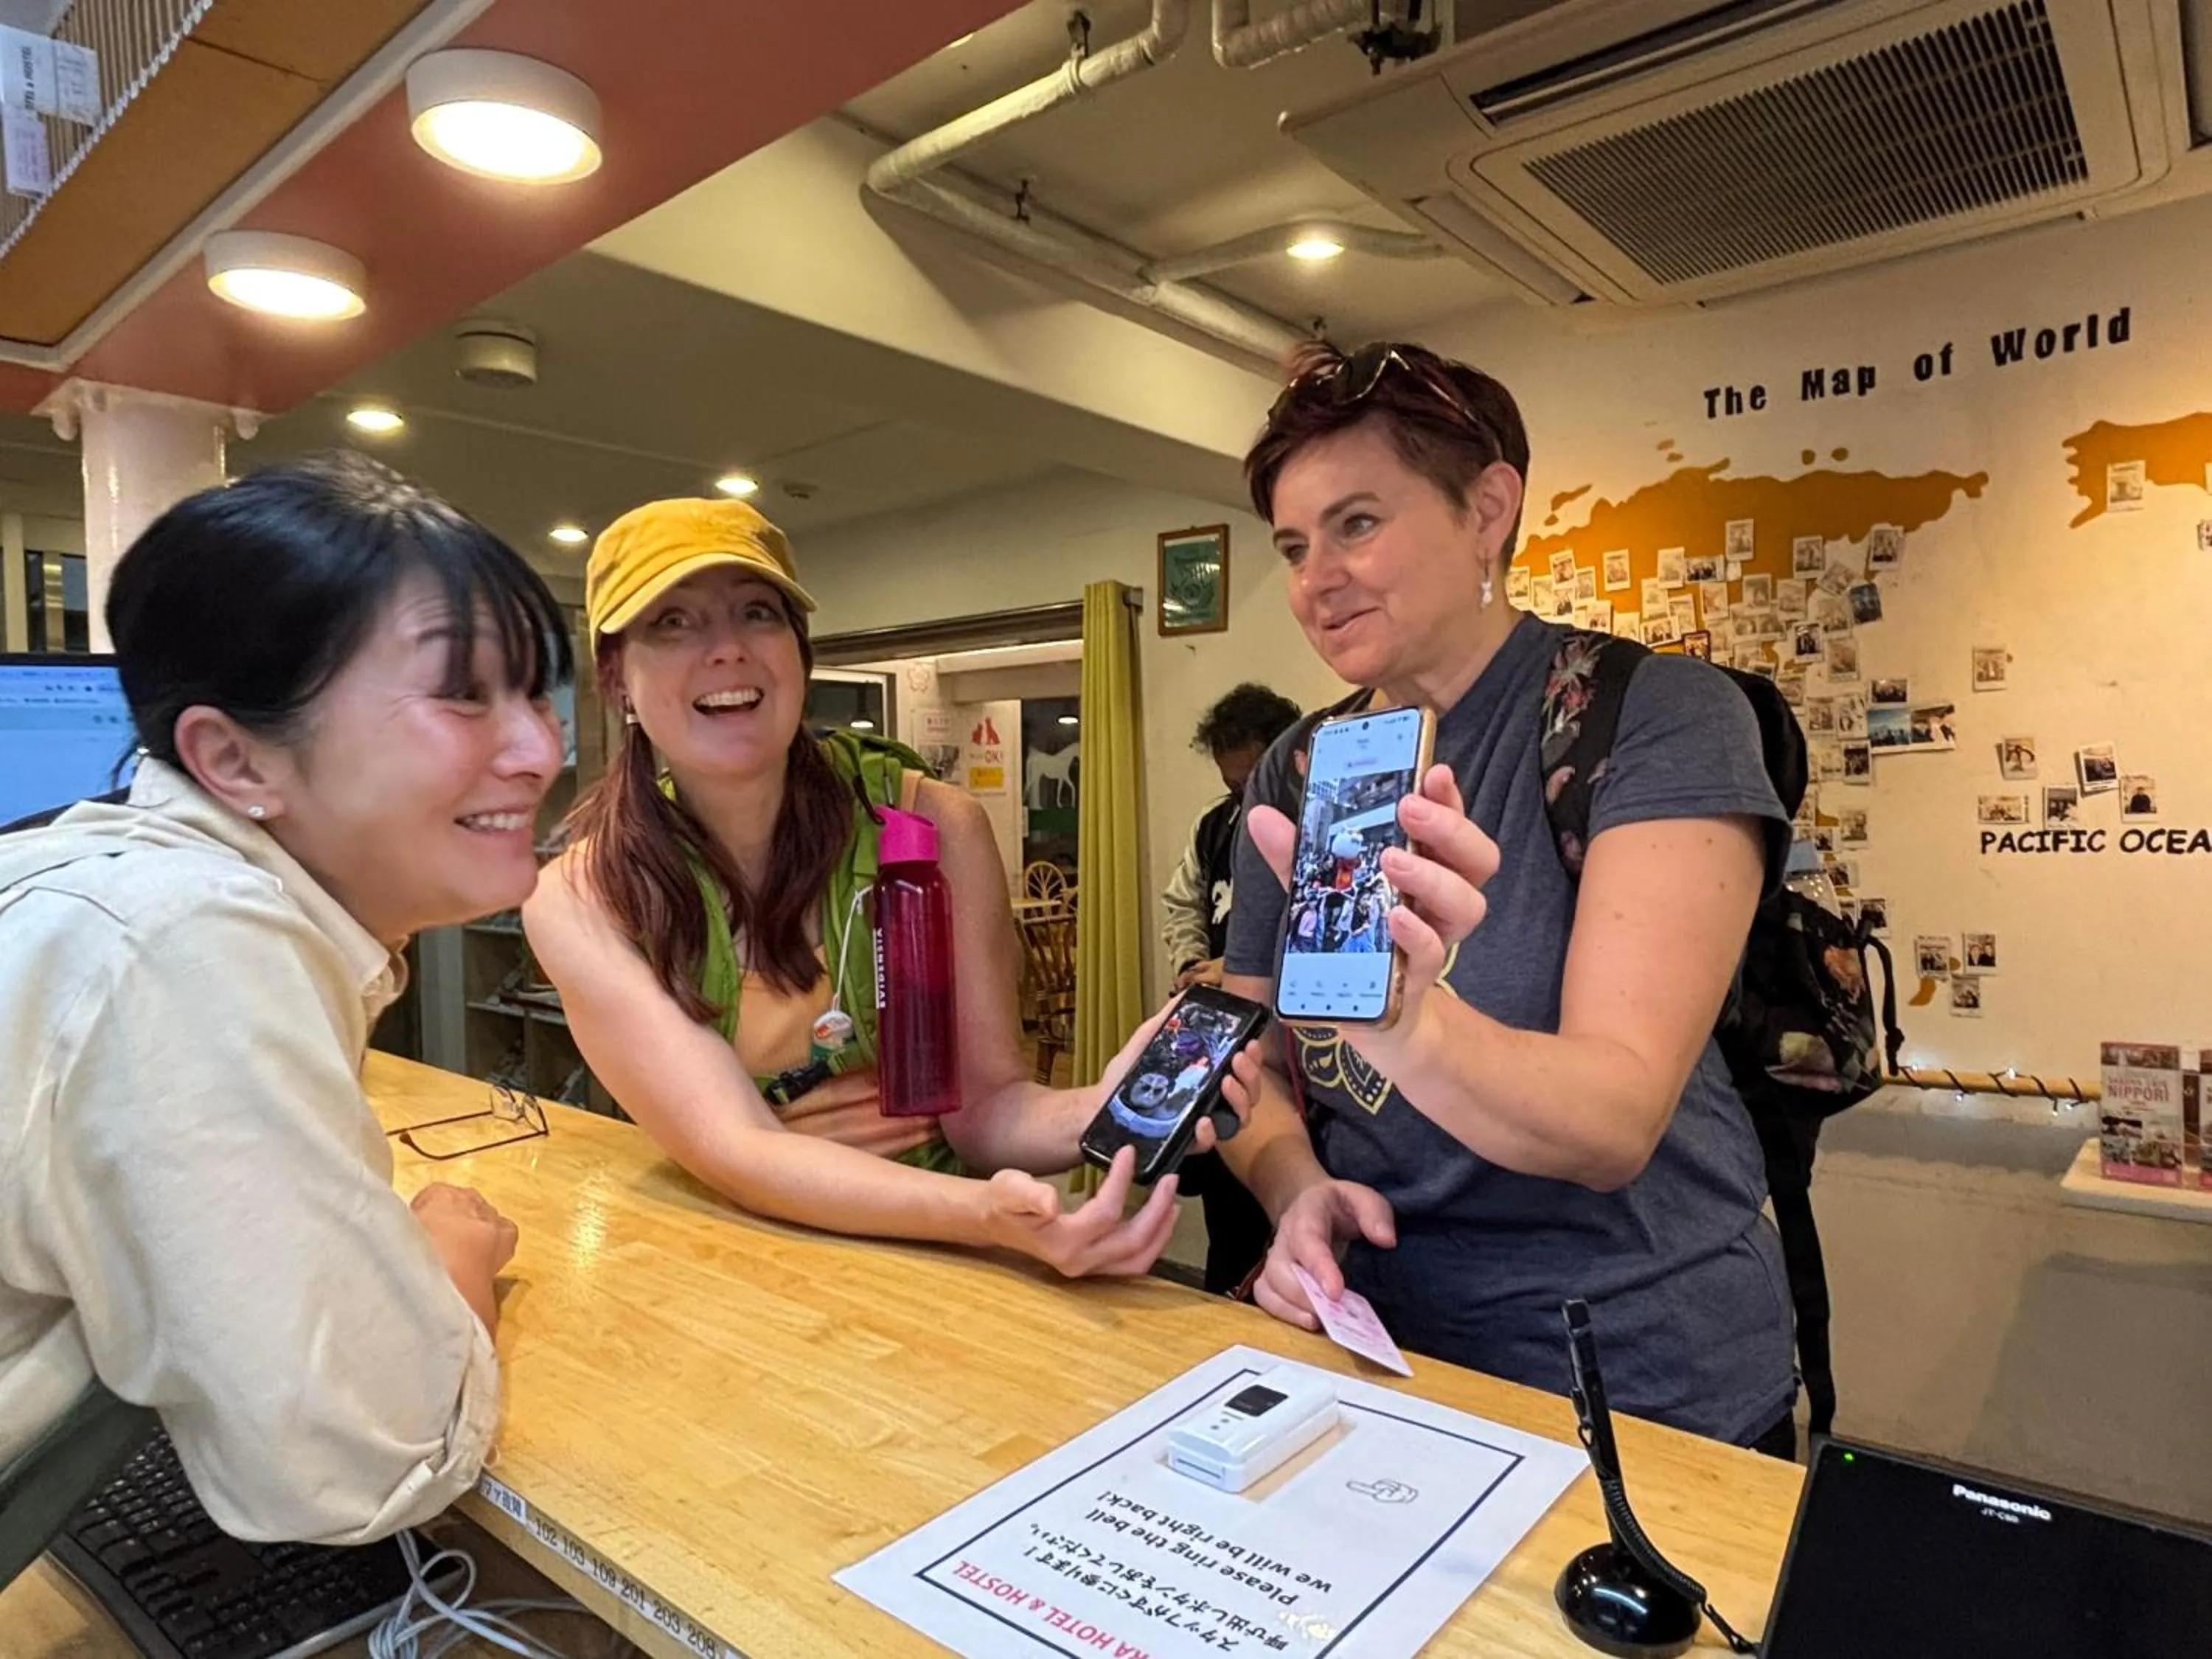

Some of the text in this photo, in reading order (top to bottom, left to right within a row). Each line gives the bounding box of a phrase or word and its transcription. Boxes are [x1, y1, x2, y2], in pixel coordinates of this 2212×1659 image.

[1704, 307, 2131, 420] The Map of World
[1980, 828, 2212, 854] PACIFIC OCEA
[877, 928, 886, 1009] EVIDENSIA
[2108, 1085, 2169, 1102] NIPPORI
[1952, 1484, 2052, 1520] Panasonic
[1085, 1508, 1300, 1606] Please ring the bell
[1096, 1490, 1332, 1593] we will be right back!
[535, 1517, 558, 1546] 102
[621, 1577, 645, 1610] 201
[653, 1599, 680, 1634] 203
[687, 1623, 716, 1659] 208
[953, 1560, 1029, 1605] HOSTEL
[1028, 1598, 1046, 1612] &
[1041, 1607, 1116, 1650] HOTEL
